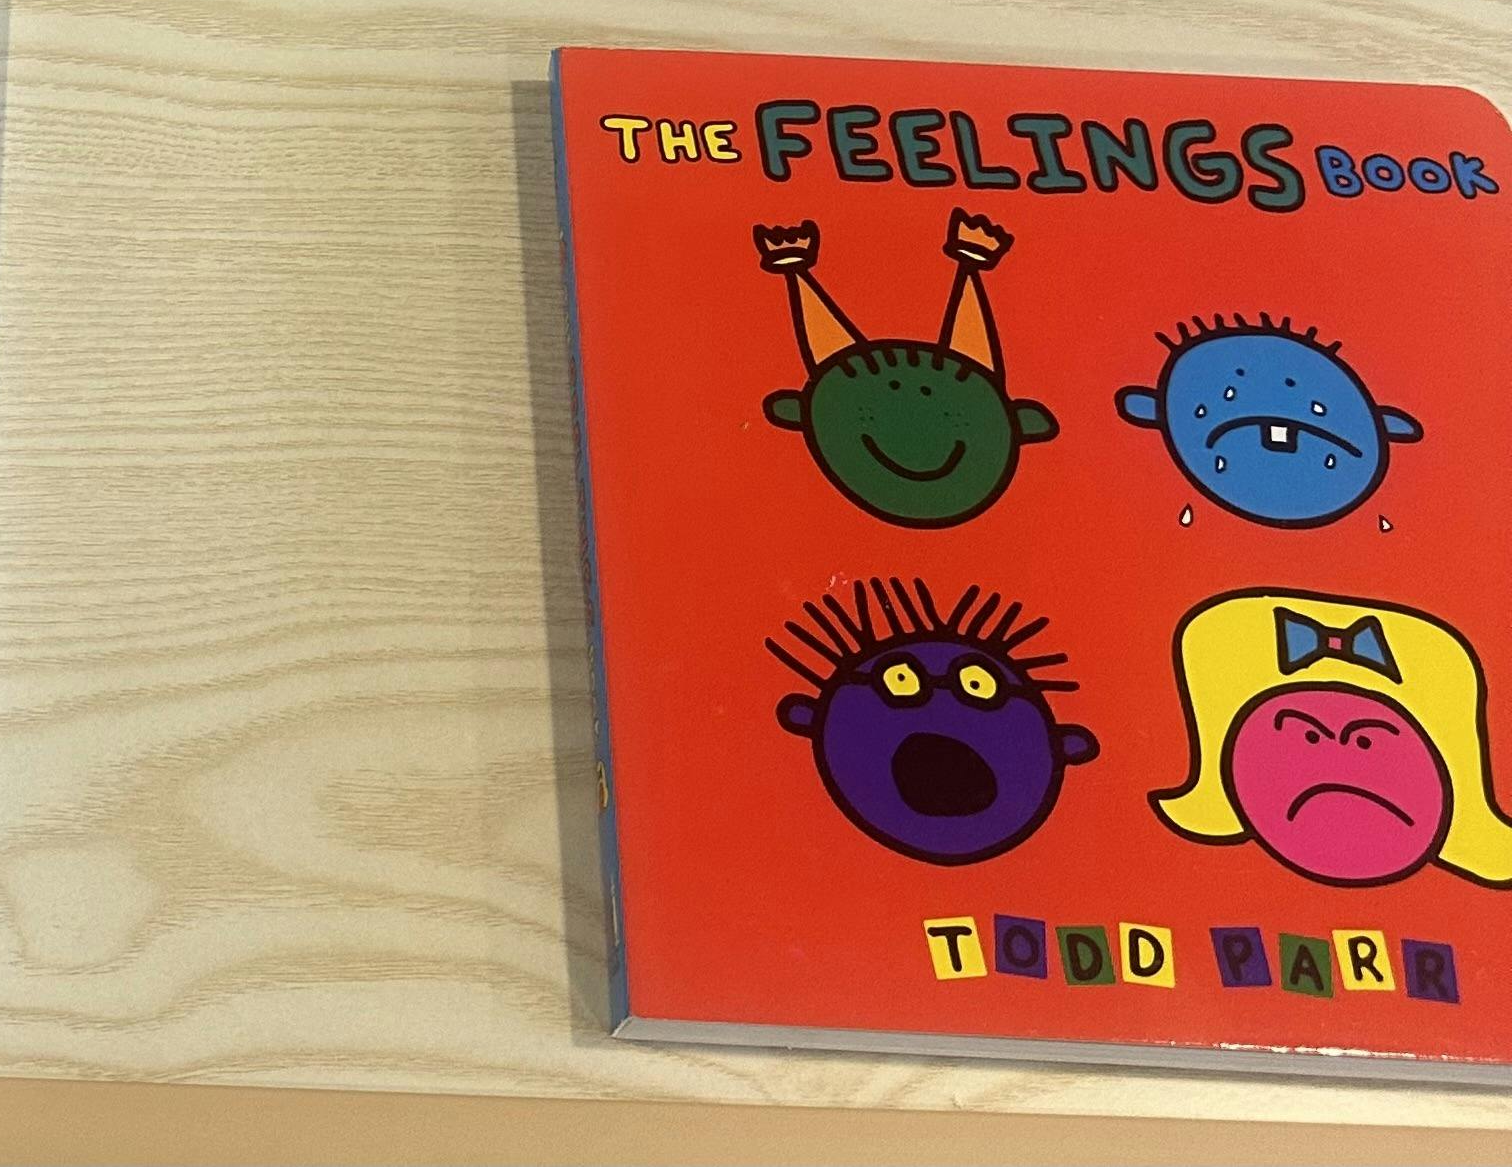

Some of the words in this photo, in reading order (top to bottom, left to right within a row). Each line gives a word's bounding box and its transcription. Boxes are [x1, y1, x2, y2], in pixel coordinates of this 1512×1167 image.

[600, 114, 740, 164] THE
[755, 100, 1307, 212] FEELINGS
[1315, 145, 1501, 199] BOOK
[926, 920, 1170, 984] TODD
[1216, 930, 1452, 1000] PARR
